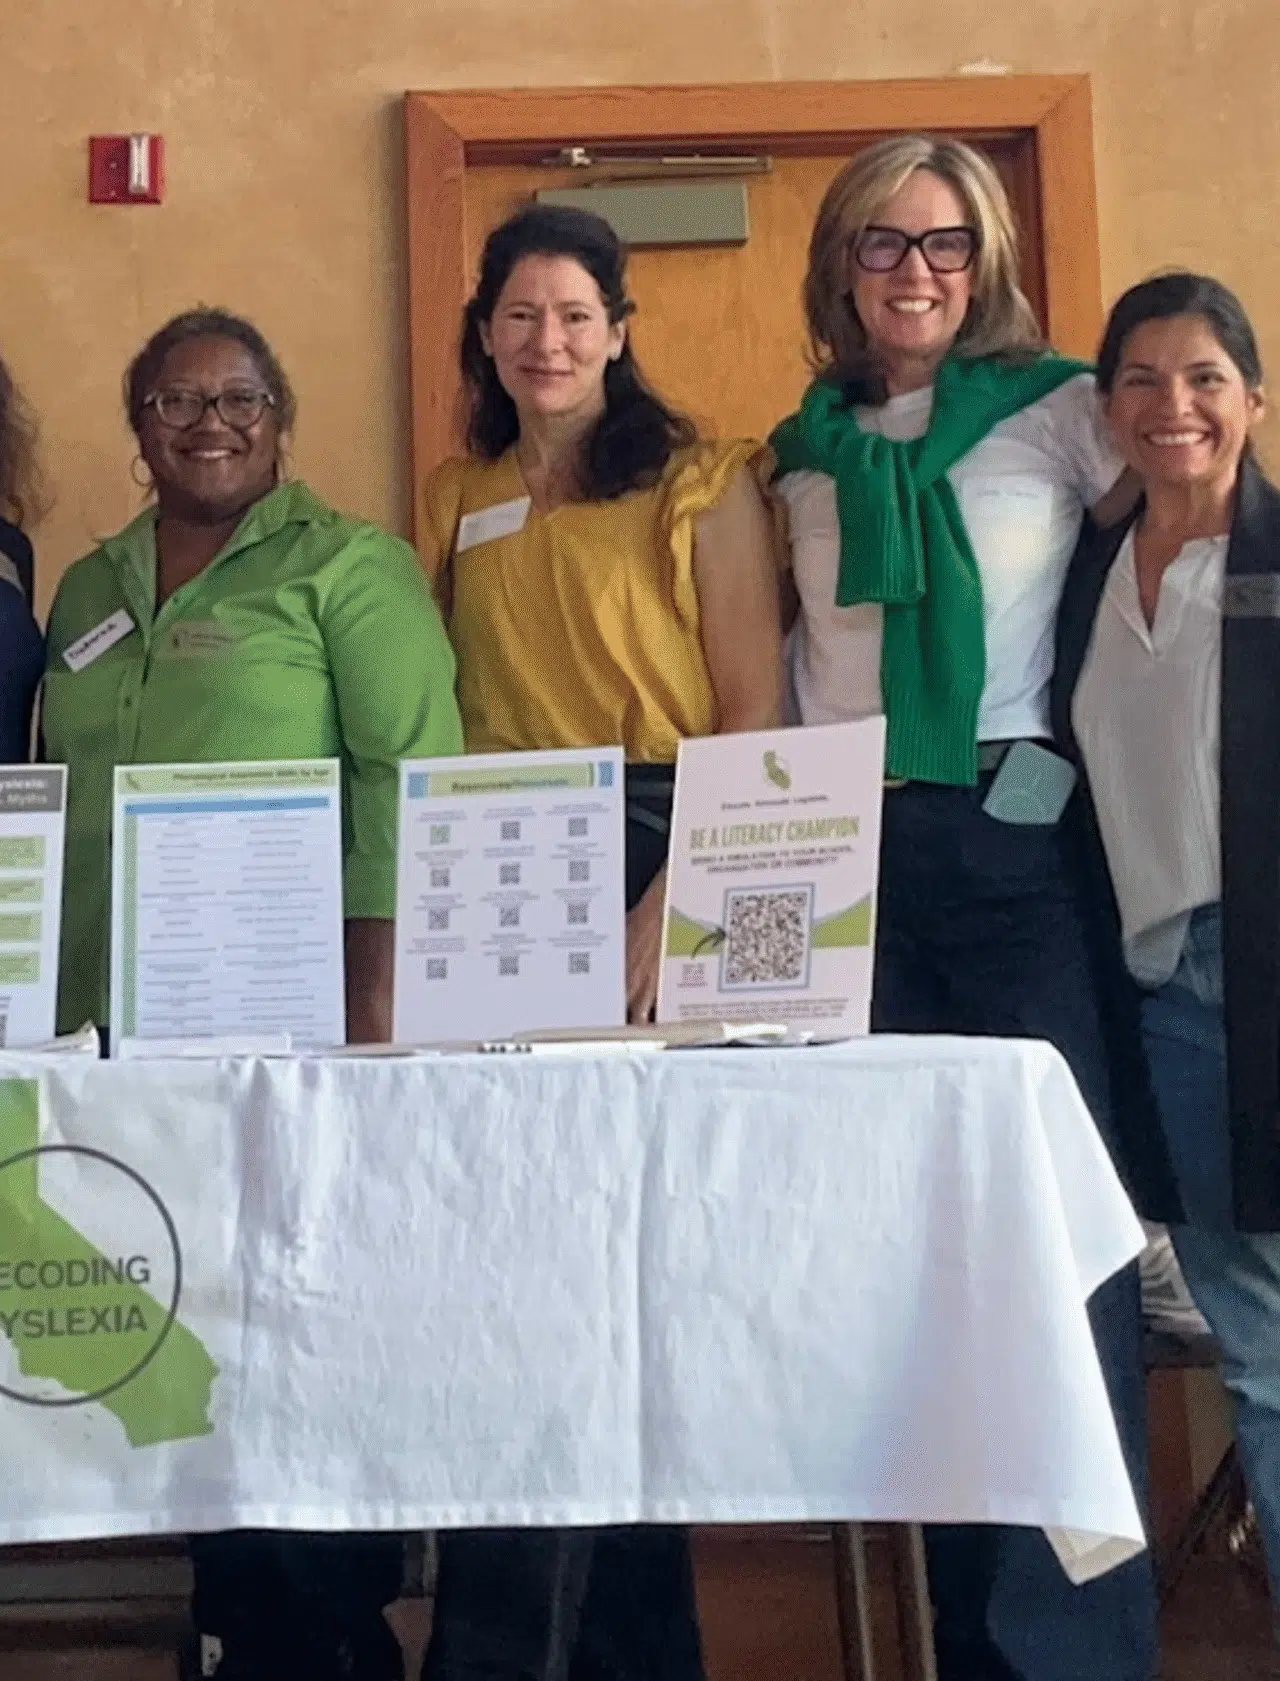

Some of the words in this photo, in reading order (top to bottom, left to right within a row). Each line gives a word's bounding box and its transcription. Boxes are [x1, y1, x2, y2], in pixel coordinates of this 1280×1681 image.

[690, 828, 706, 849] BE
[710, 827, 718, 847] A
[722, 821, 785, 847] LITERACY
[787, 816, 860, 841] CHAMPION
